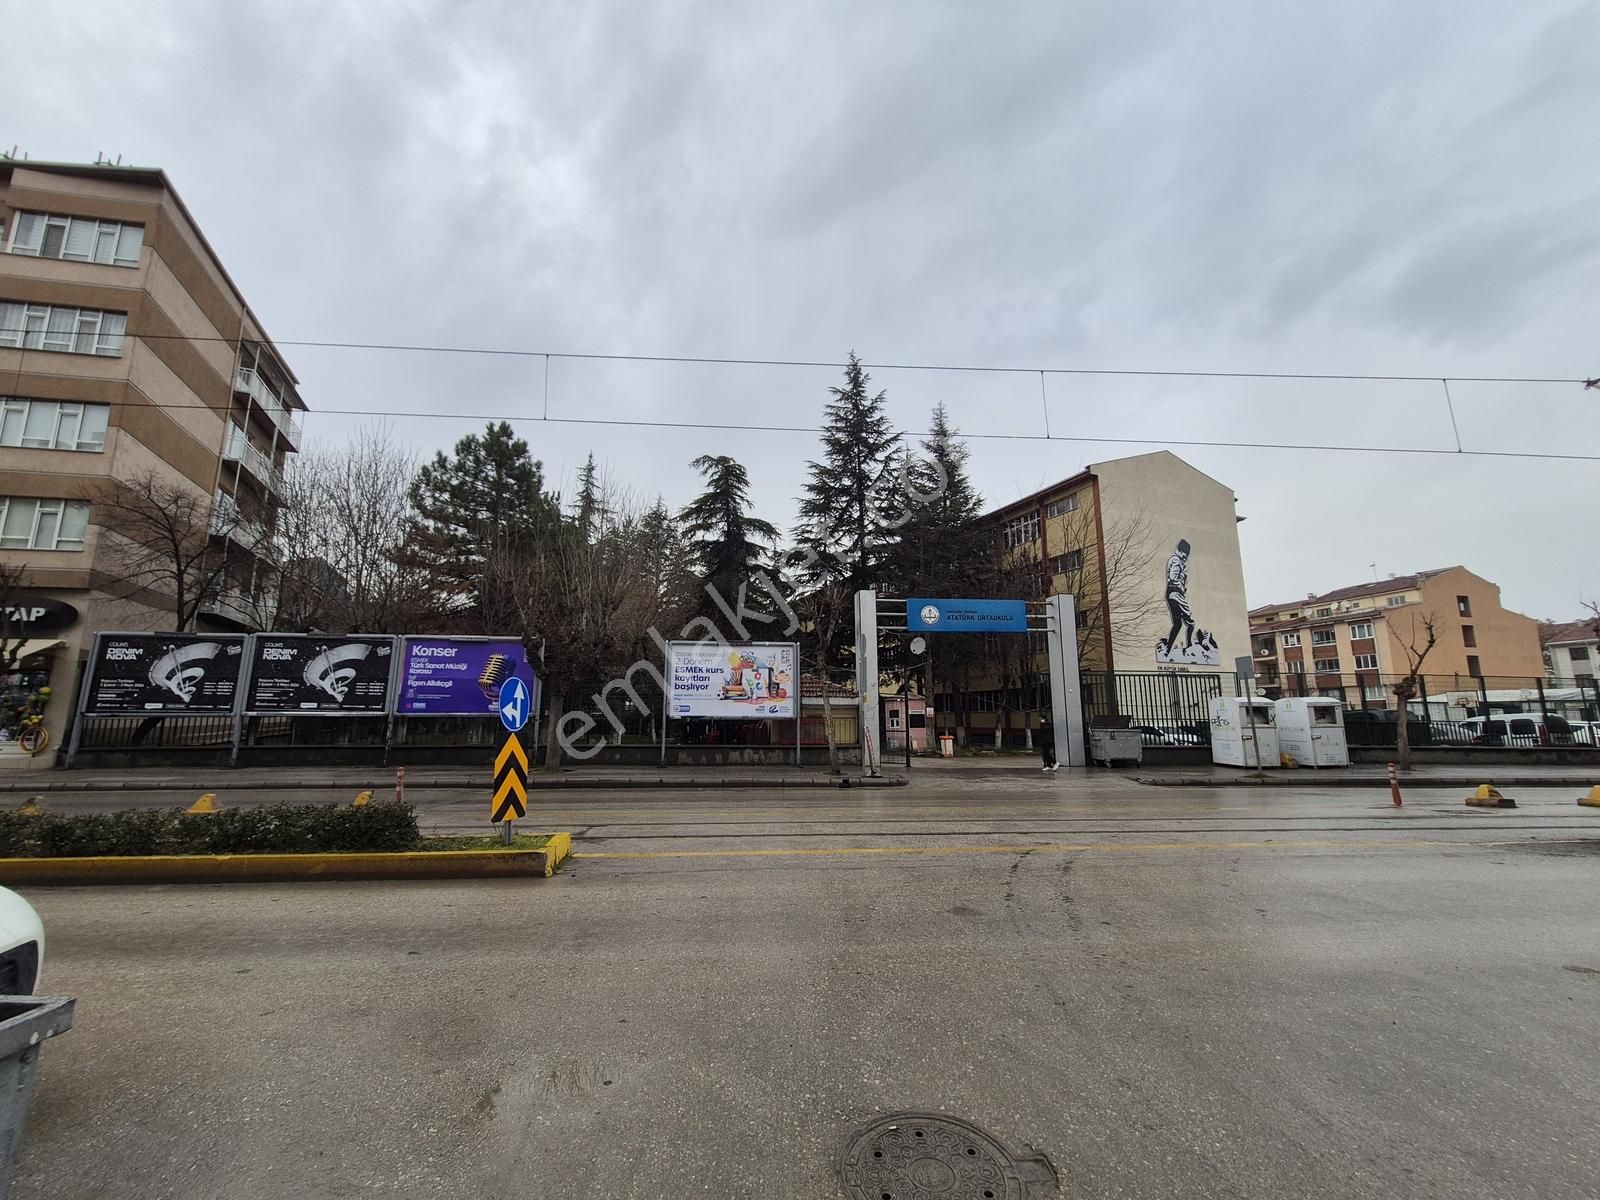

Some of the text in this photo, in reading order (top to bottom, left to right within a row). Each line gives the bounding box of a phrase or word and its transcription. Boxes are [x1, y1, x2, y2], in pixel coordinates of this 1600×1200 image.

[977, 614, 1014, 622] ORTAOKULU
[412, 645, 458, 656] Konser
[445, 663, 468, 671] Müziği
[675, 666, 725, 674] ESMEK kurs
[674, 673, 711, 683] kayıtları
[674, 682, 710, 692] başlıyor
